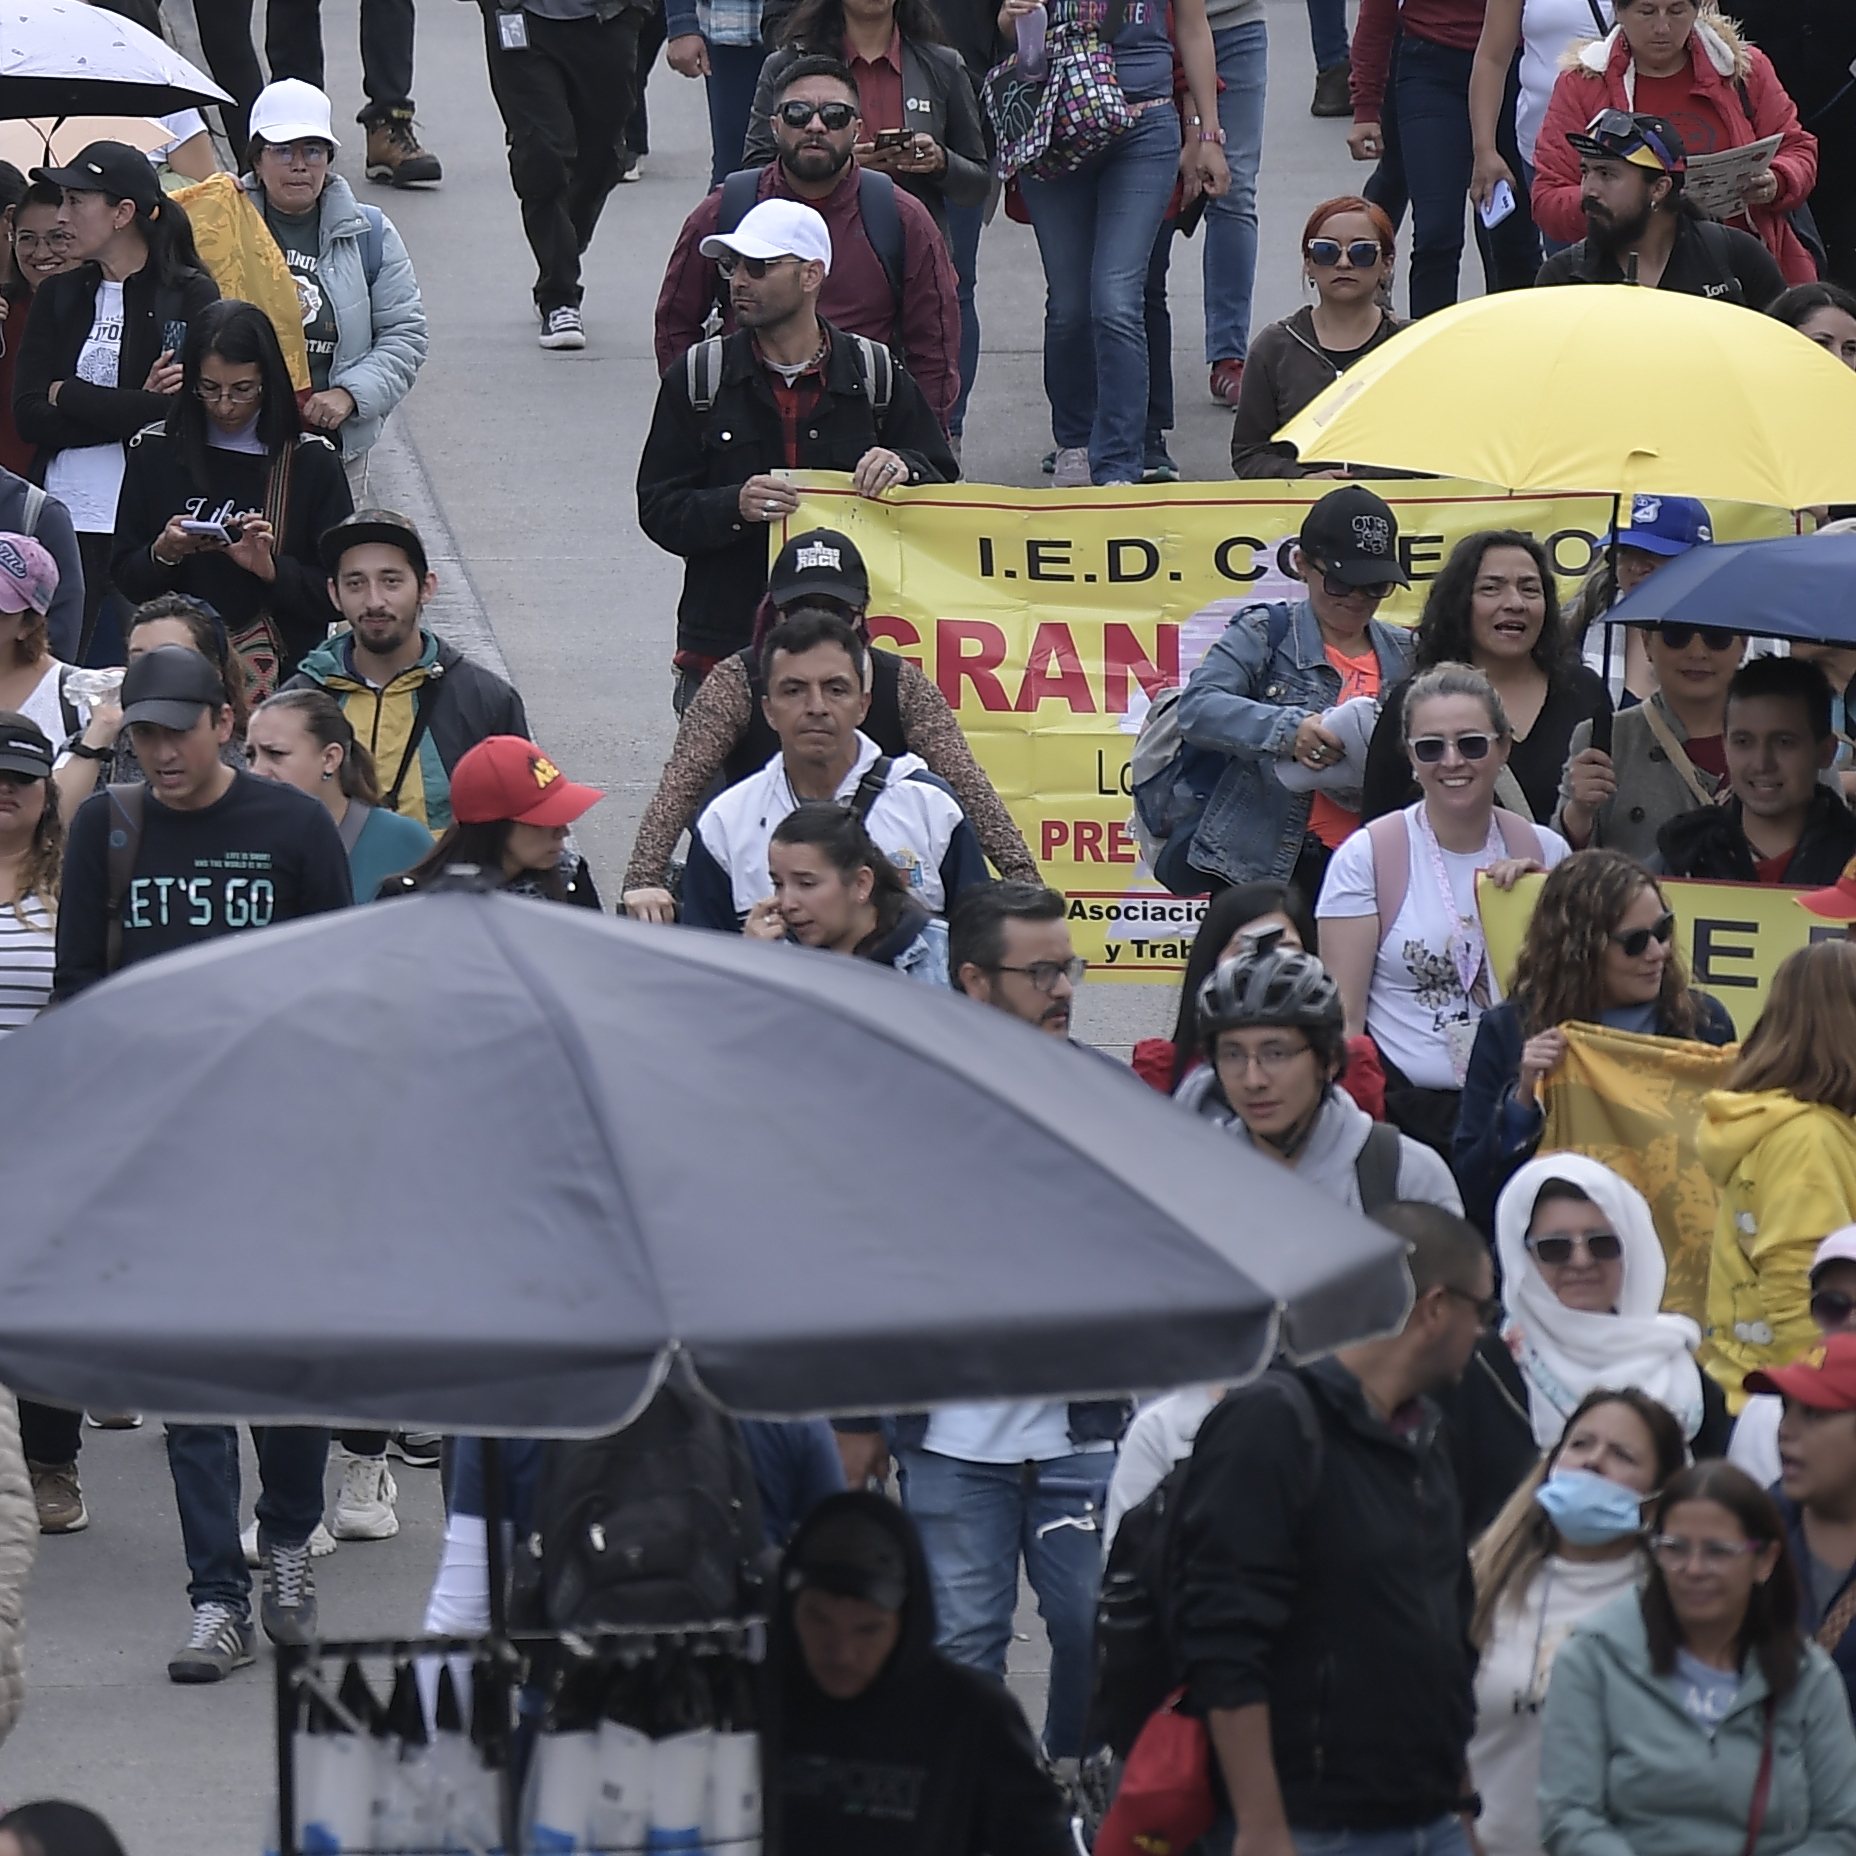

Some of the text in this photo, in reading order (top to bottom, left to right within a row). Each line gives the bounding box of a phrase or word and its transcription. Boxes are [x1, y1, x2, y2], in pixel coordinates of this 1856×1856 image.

[978, 535, 1183, 584] I.E.D.
[224, 877, 274, 927] GO
[1067, 897, 1210, 923] Asociació
[1104, 944, 1120, 963] y
